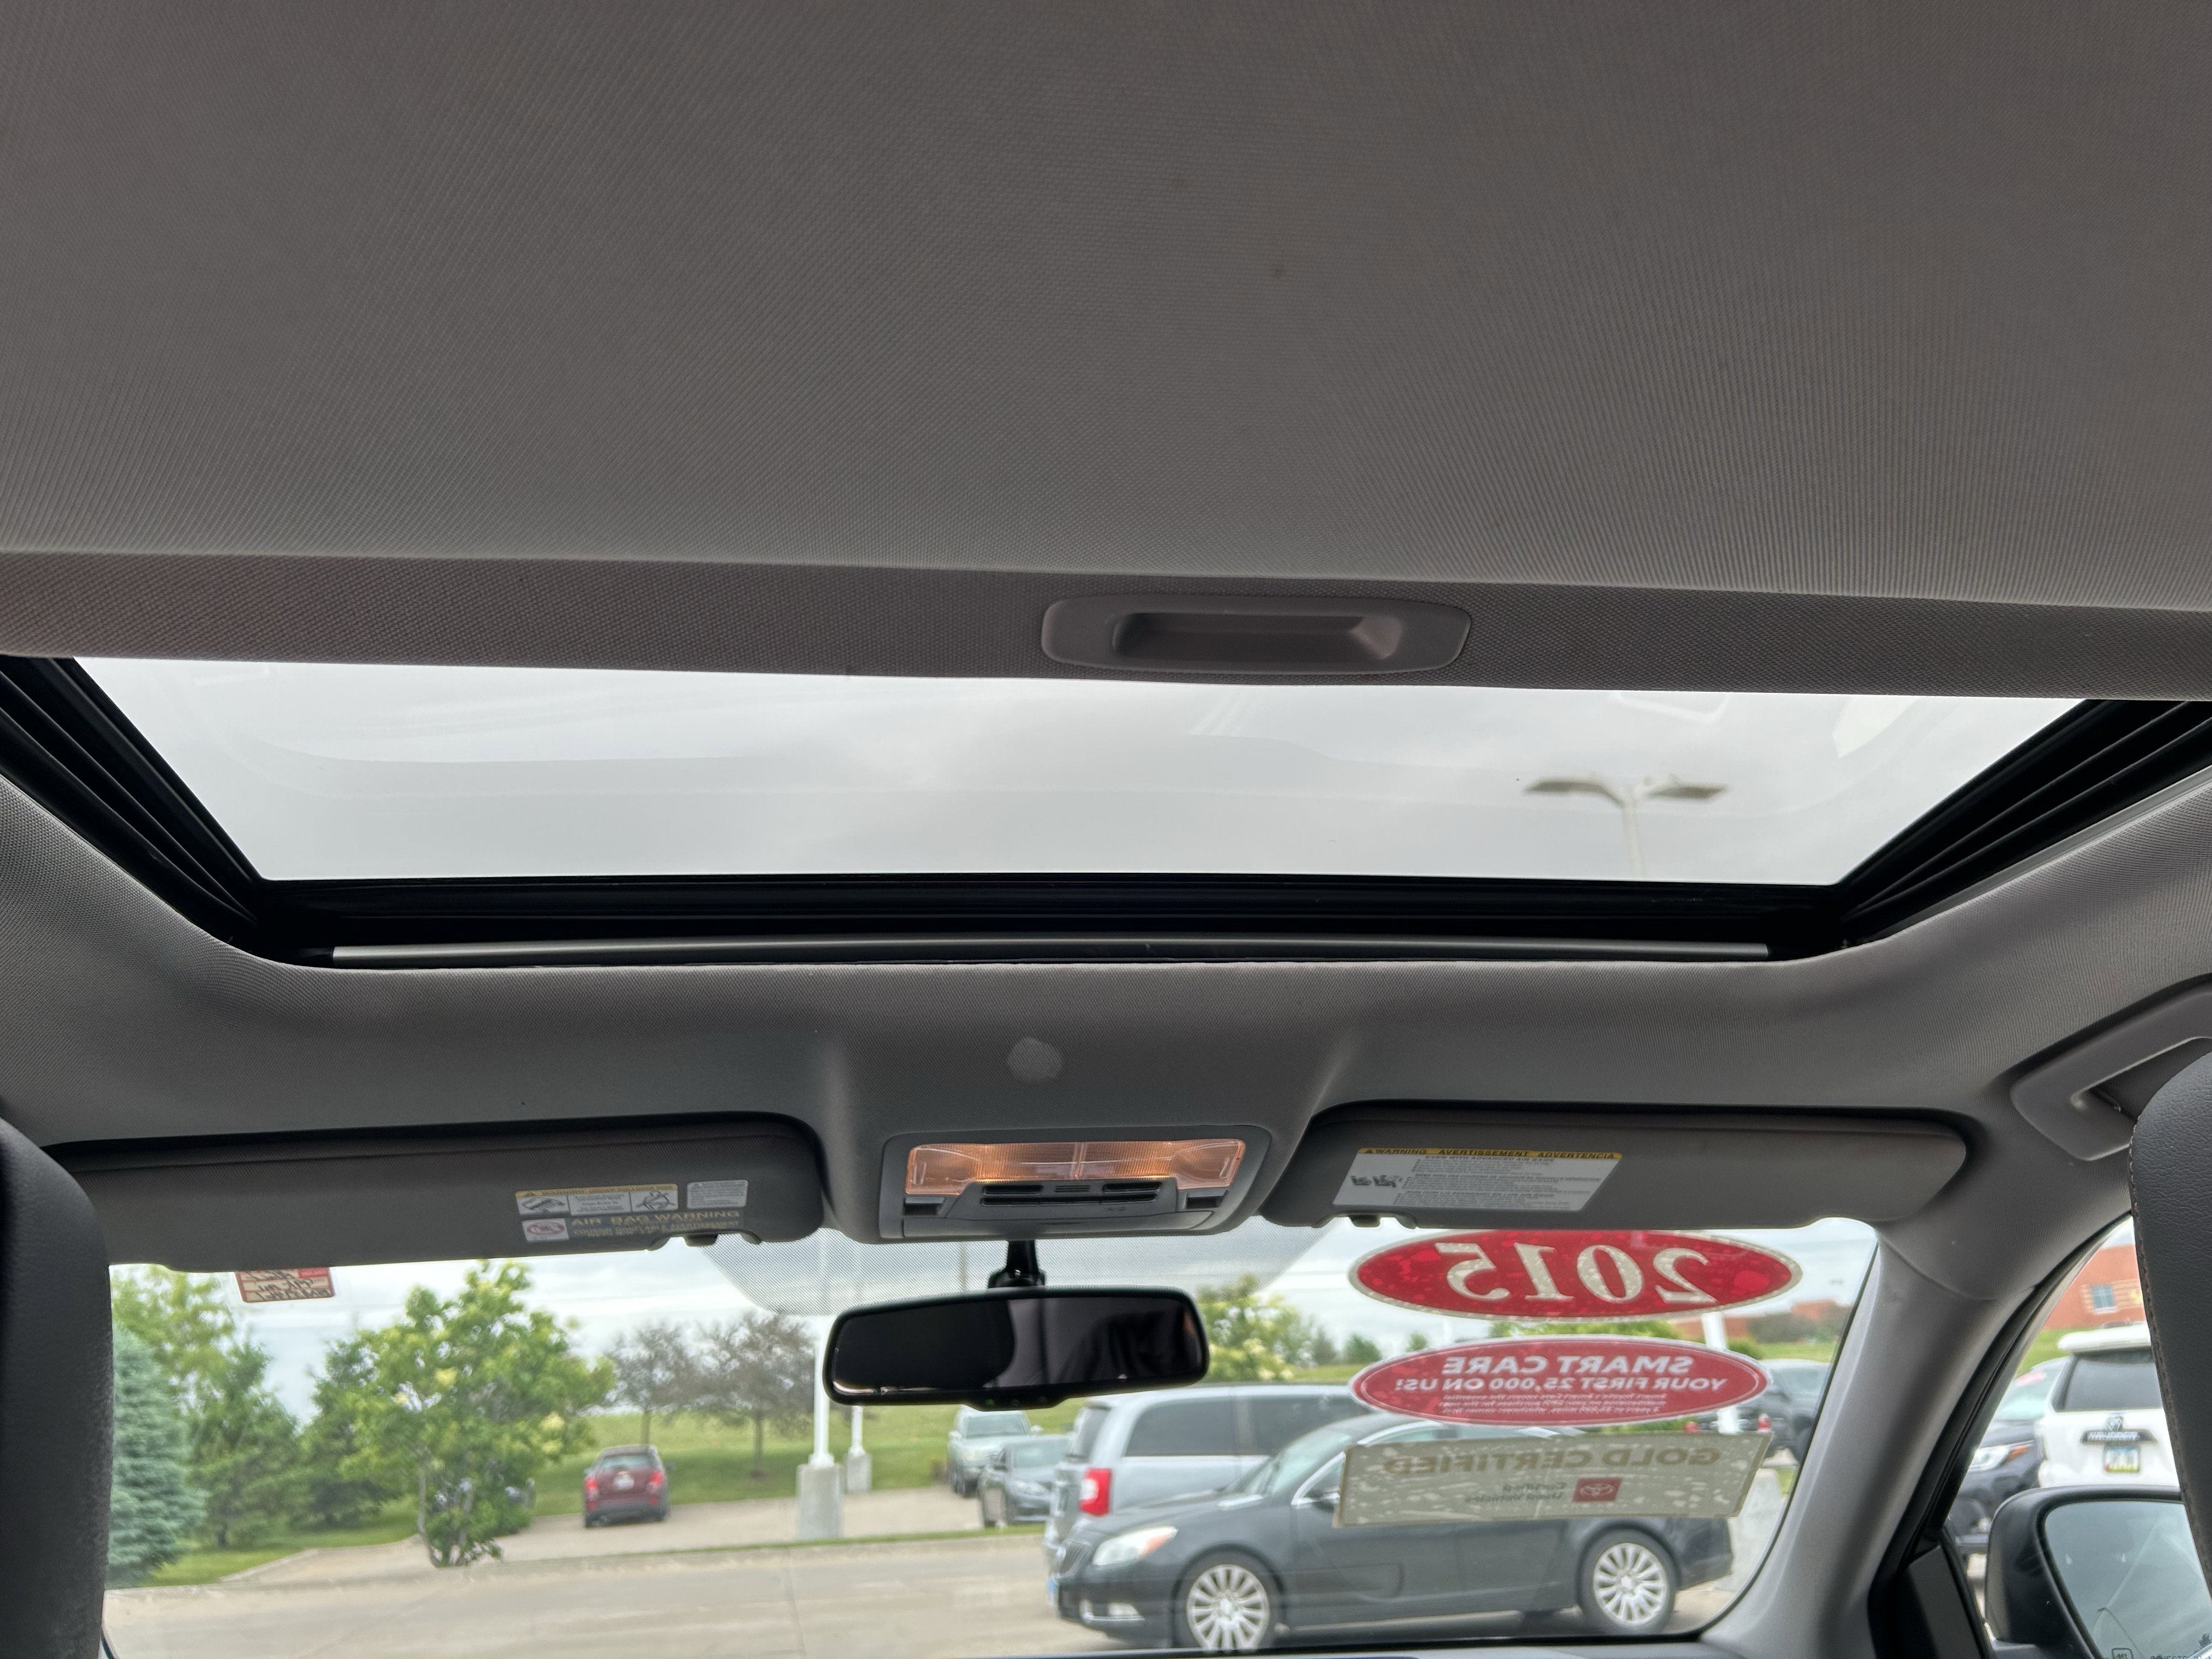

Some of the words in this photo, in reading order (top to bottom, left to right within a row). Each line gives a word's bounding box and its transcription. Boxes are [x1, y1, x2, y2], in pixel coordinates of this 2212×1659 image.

[1536, 1151, 1615, 1159] ADVERTENCIA
[571, 1217, 602, 1226] AIR
[610, 1215, 650, 1224] BAG
[654, 1210, 740, 1222] WARNING
